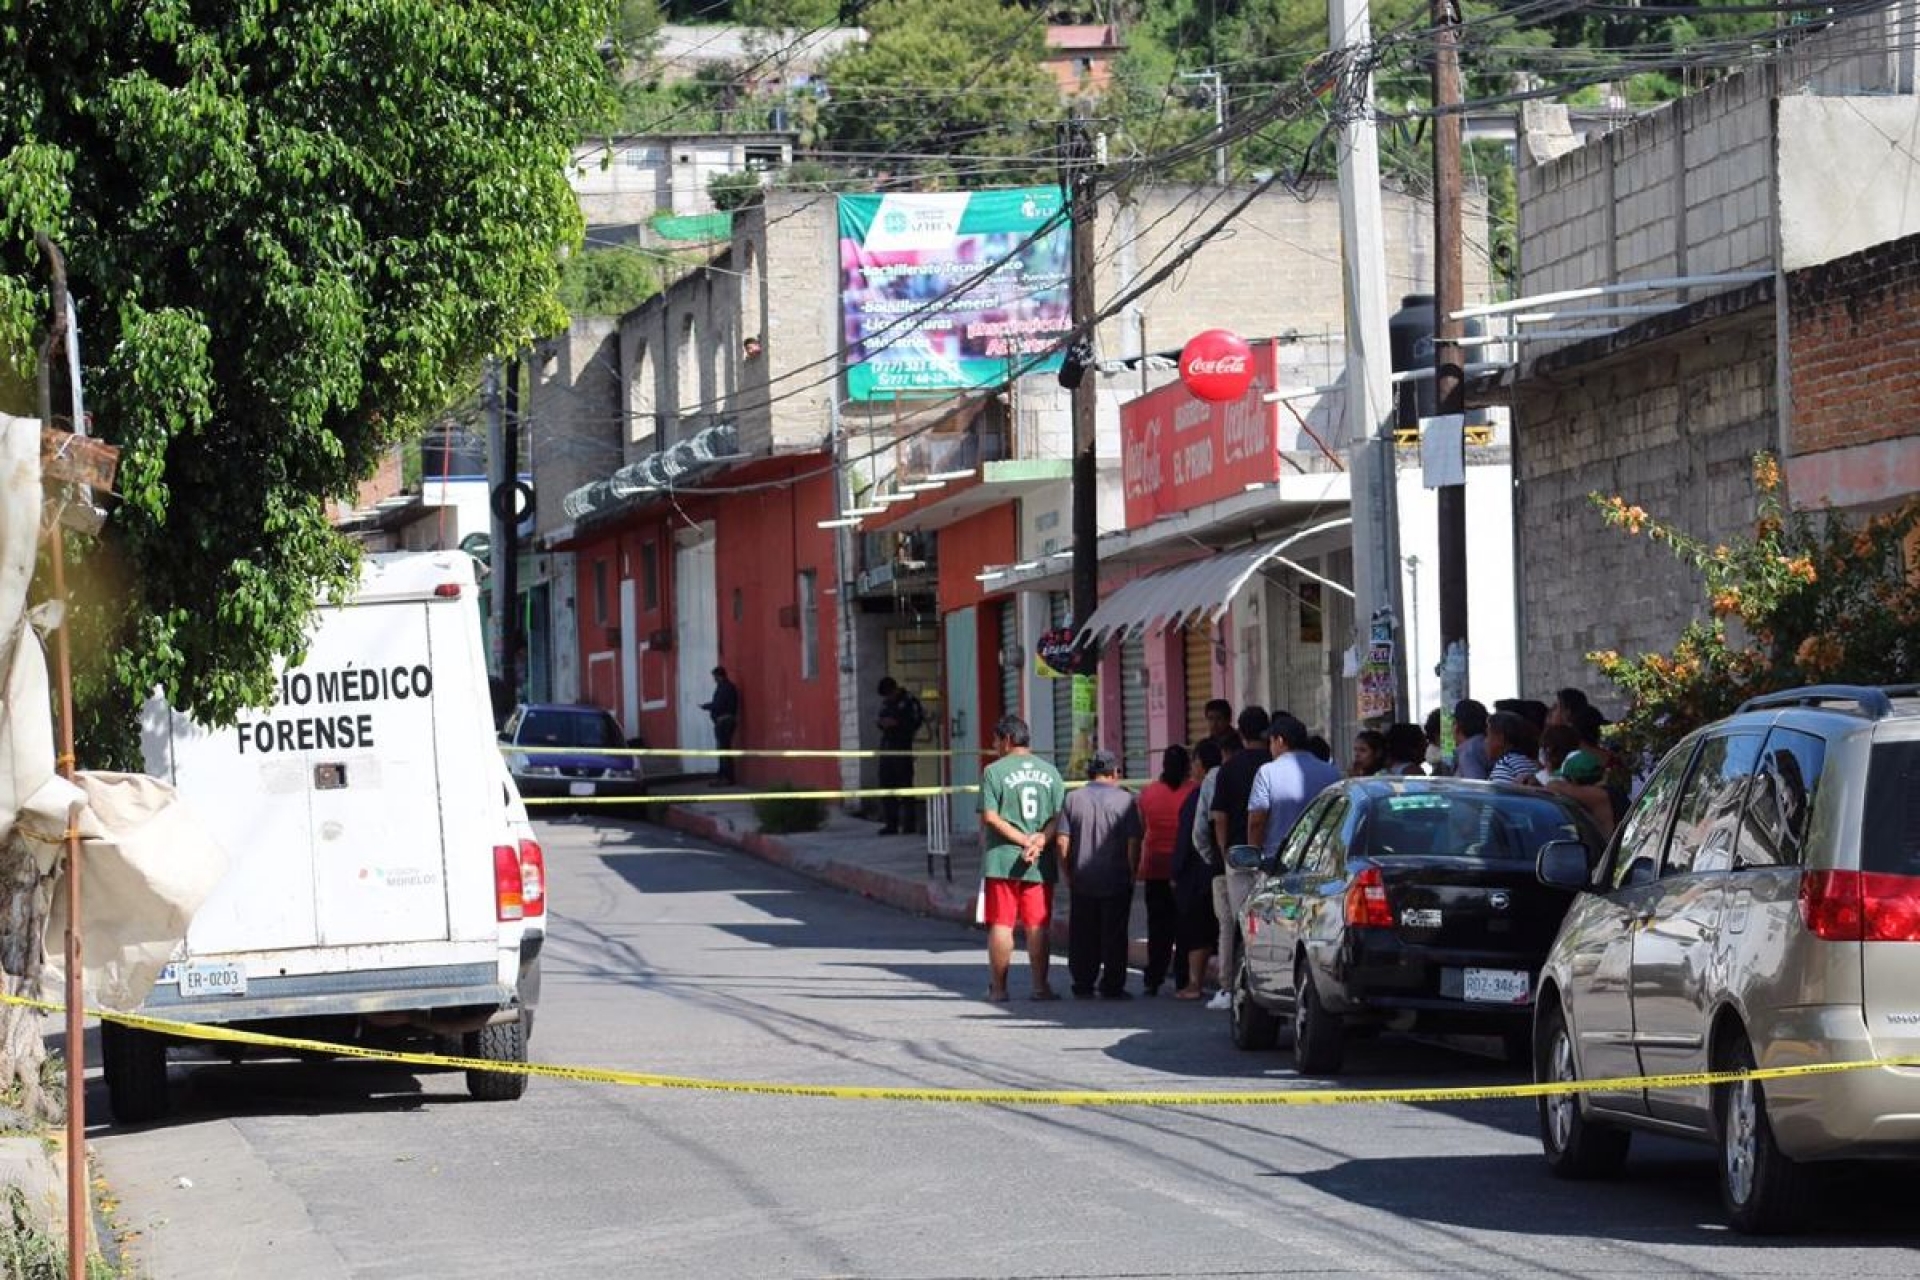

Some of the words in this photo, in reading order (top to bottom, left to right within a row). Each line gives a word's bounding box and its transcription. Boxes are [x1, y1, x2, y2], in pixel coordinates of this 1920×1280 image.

[1188, 356, 1245, 375] Coca-Cola
[316, 661, 433, 704] MÉDICO
[237, 714, 374, 754] FORENSE
[1021, 786, 1038, 820] 6
[188, 970, 239, 988] ER-0203
